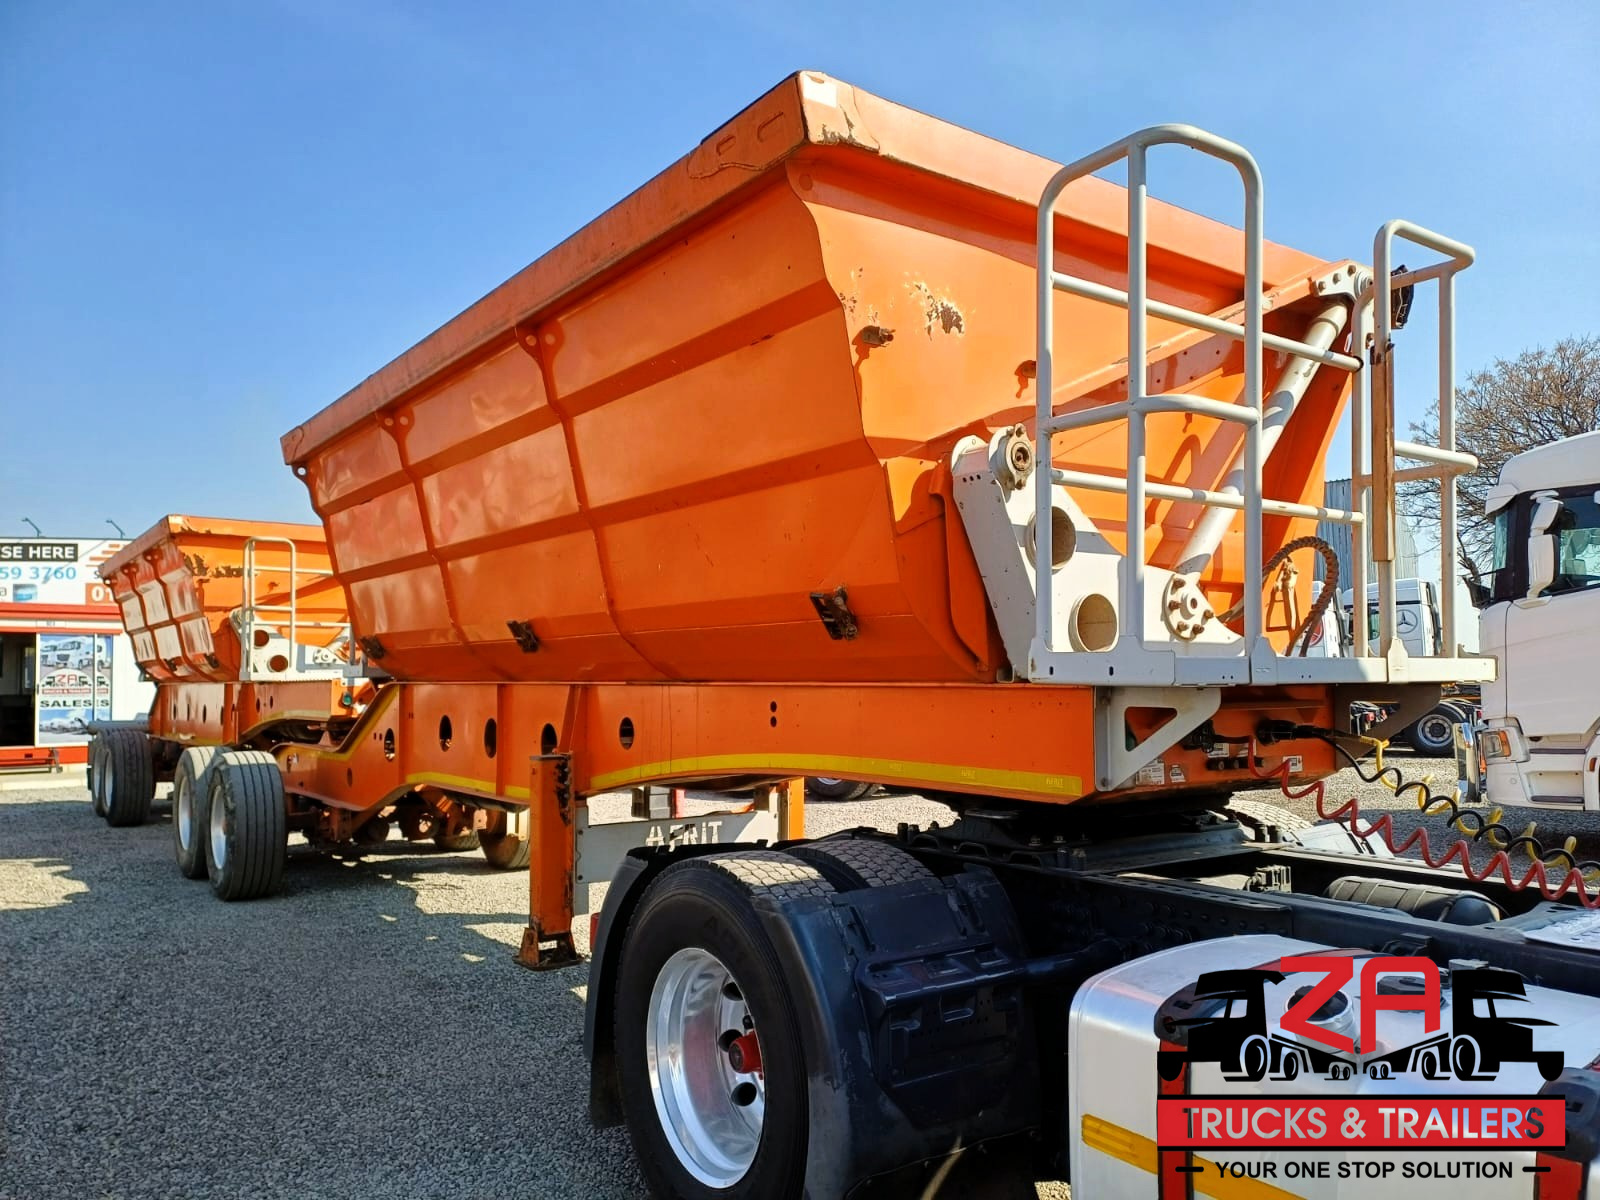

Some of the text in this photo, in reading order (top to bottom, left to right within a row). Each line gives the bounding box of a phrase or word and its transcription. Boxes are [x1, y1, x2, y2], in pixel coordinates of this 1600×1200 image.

[0, 546, 74, 559] SE HERE
[0, 567, 77, 580] 59 3760
[40, 700, 92, 708] SALES
